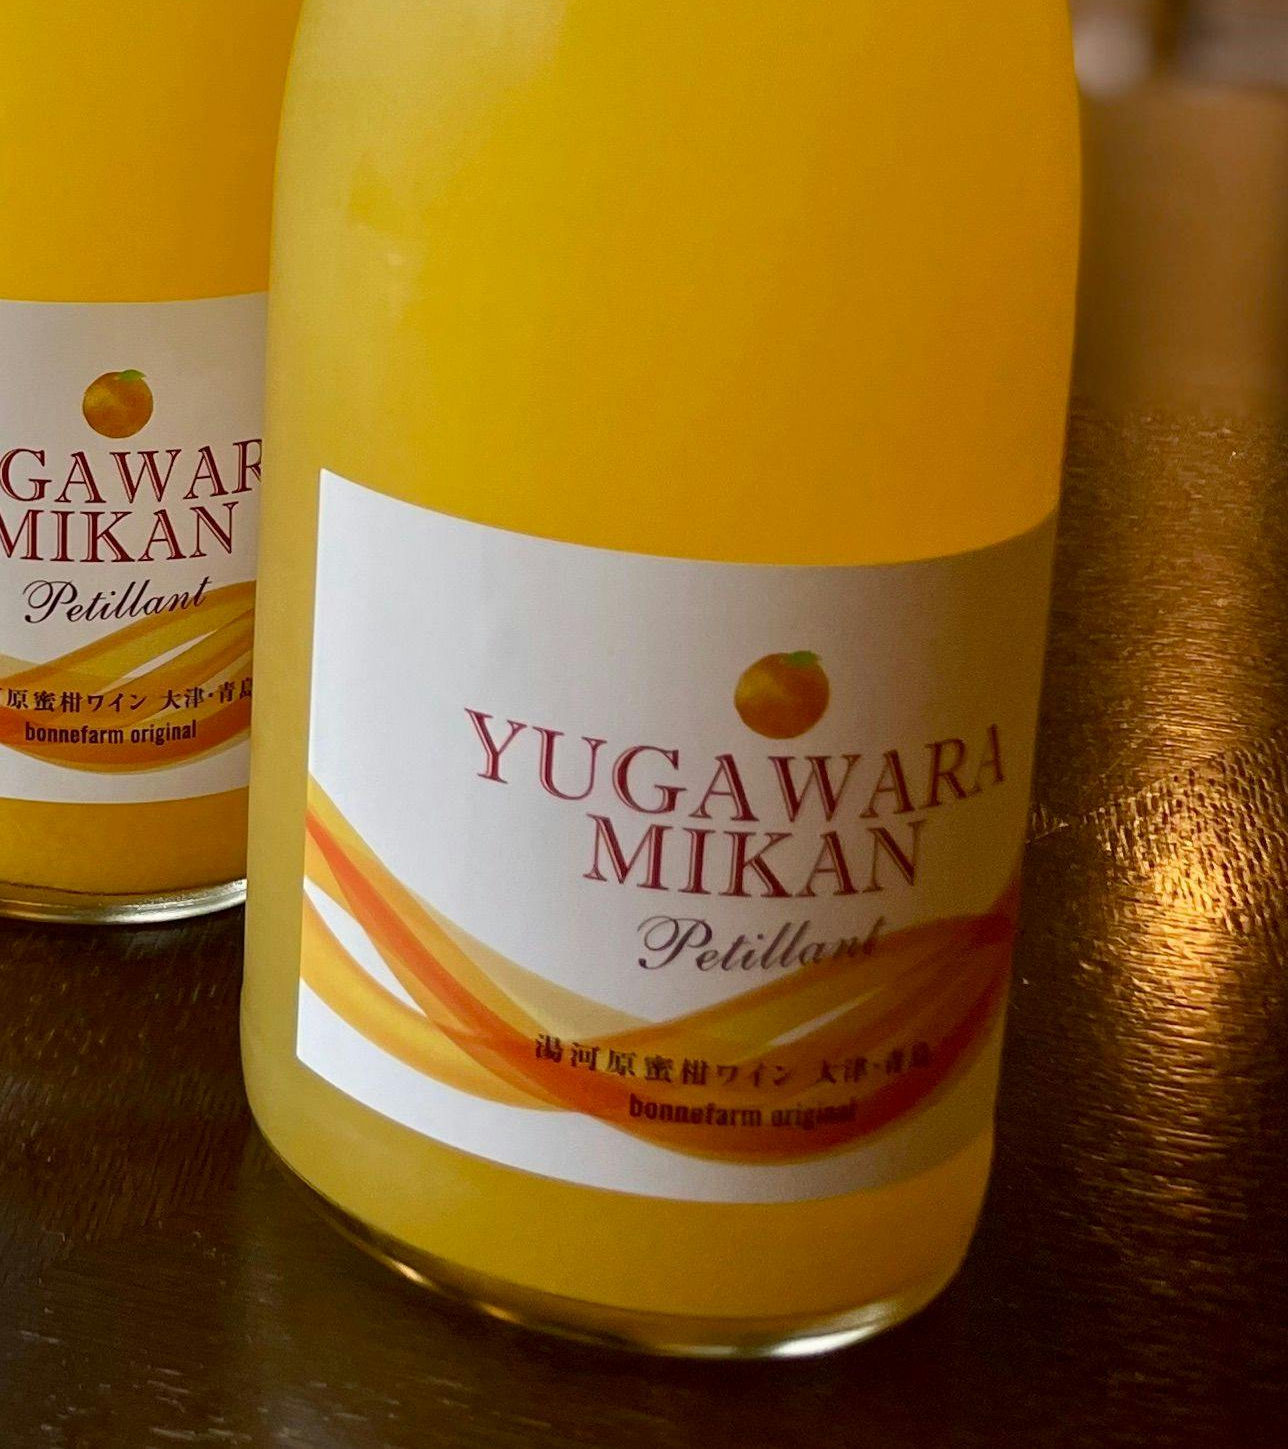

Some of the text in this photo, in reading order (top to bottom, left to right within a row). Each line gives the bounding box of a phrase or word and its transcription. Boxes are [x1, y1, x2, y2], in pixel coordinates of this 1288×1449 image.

[22, 575, 212, 624] Petillant
[25, 719, 197, 746] bonnefarm original
[464, 708, 1005, 823] YUGAWARA
[582, 813, 925, 898] MIKAN
[637, 915, 886, 971] Petillant
[629, 1093, 762, 1127] bonnefarm
